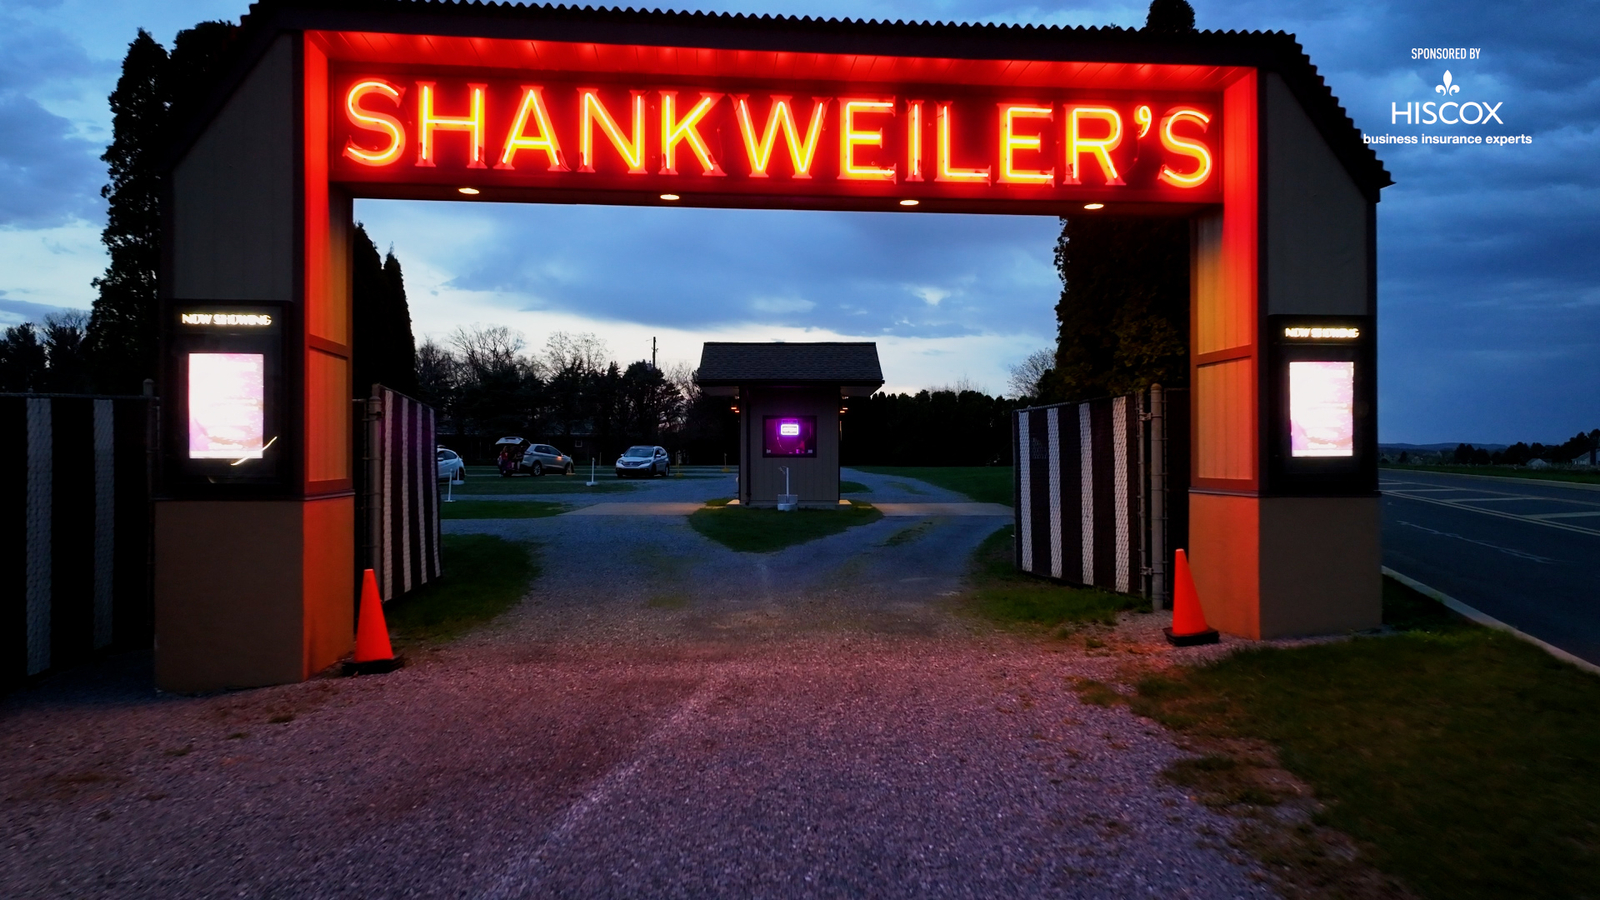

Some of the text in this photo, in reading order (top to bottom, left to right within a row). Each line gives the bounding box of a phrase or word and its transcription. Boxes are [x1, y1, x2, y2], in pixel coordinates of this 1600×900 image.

[344, 77, 1214, 189] SHANKWEILER'S
[181, 313, 272, 326] NOW SHOWING
[1285, 327, 1310, 338] NOW
